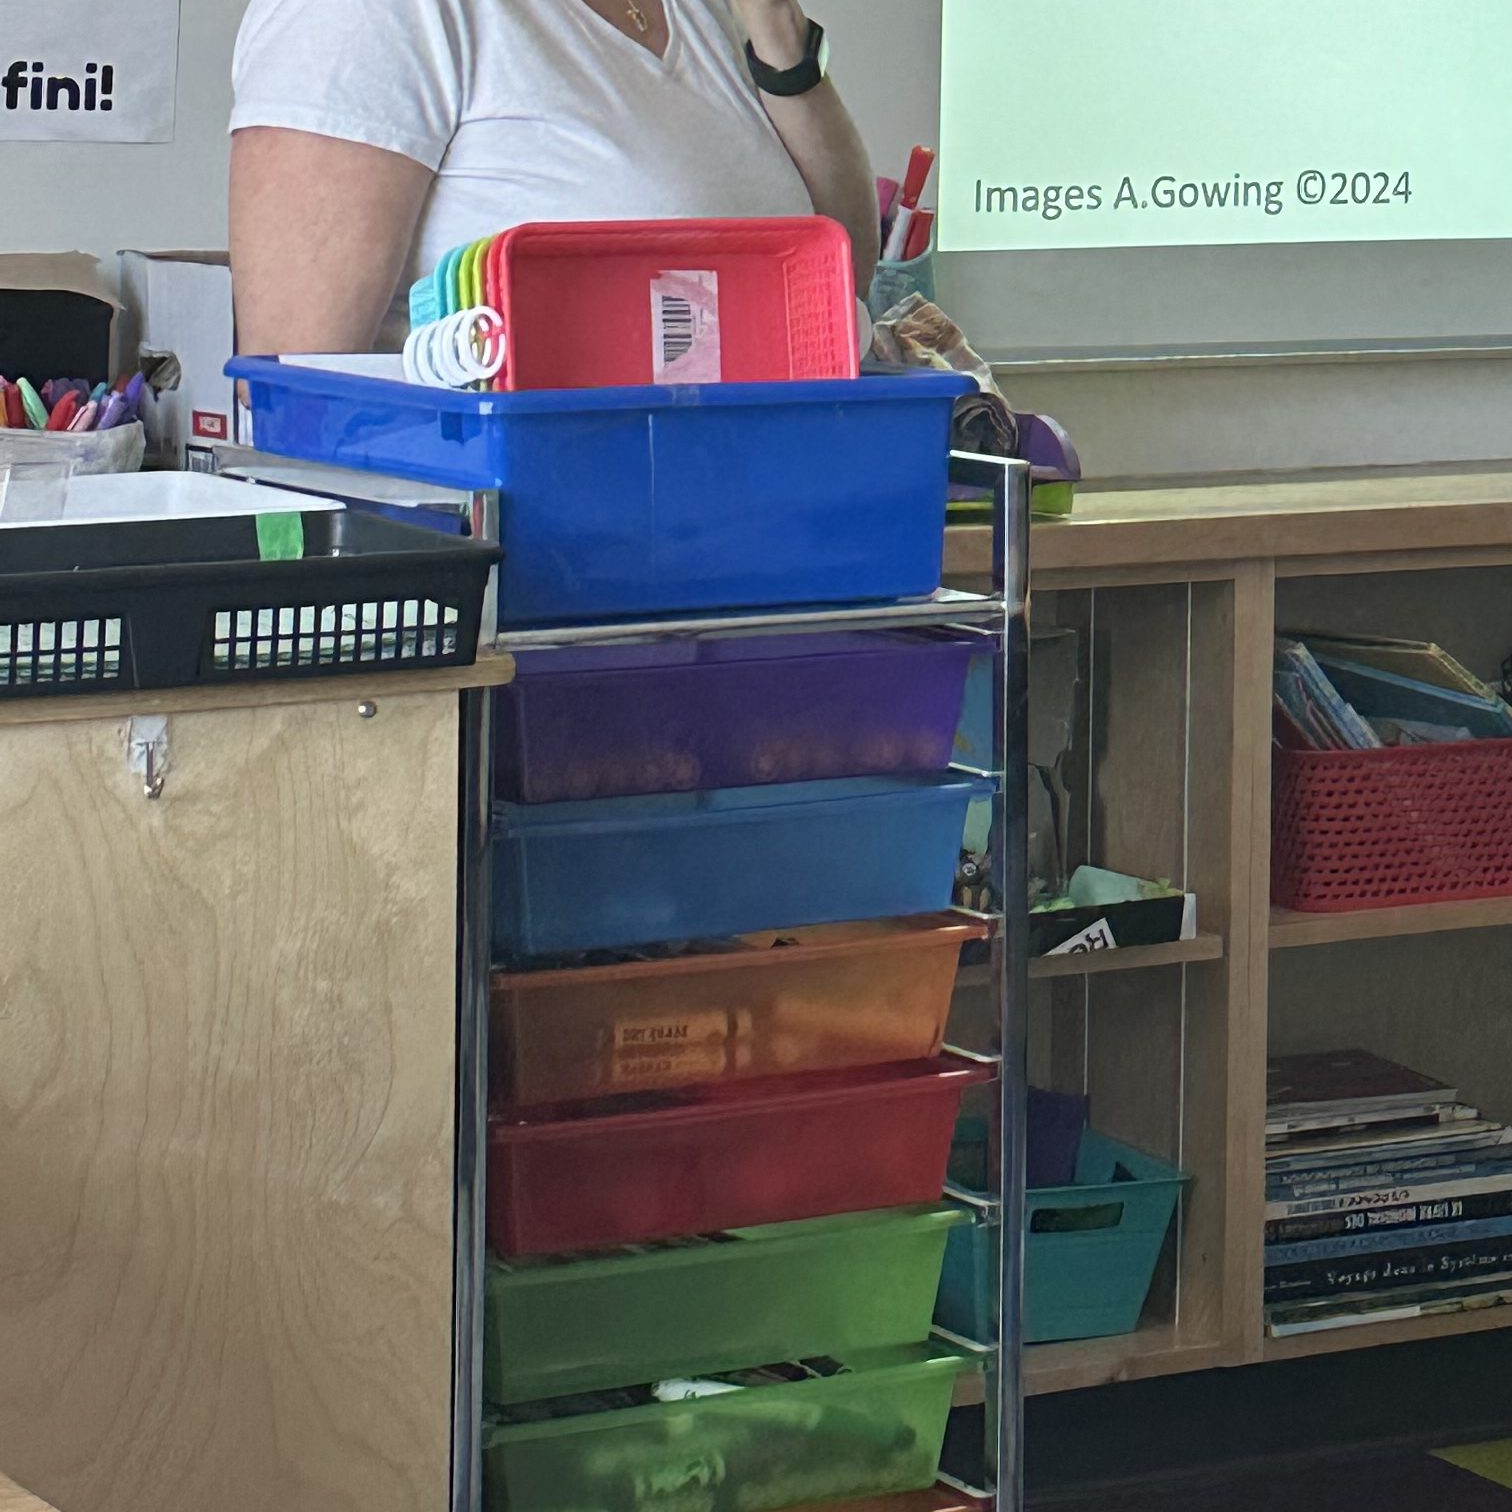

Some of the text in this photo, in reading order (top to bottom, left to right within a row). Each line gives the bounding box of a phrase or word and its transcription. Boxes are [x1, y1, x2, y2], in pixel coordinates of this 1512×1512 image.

[2, 60, 114, 112] fini!
[975, 179, 1102, 220] Images
[1113, 172, 1284, 216] A.Gowing
